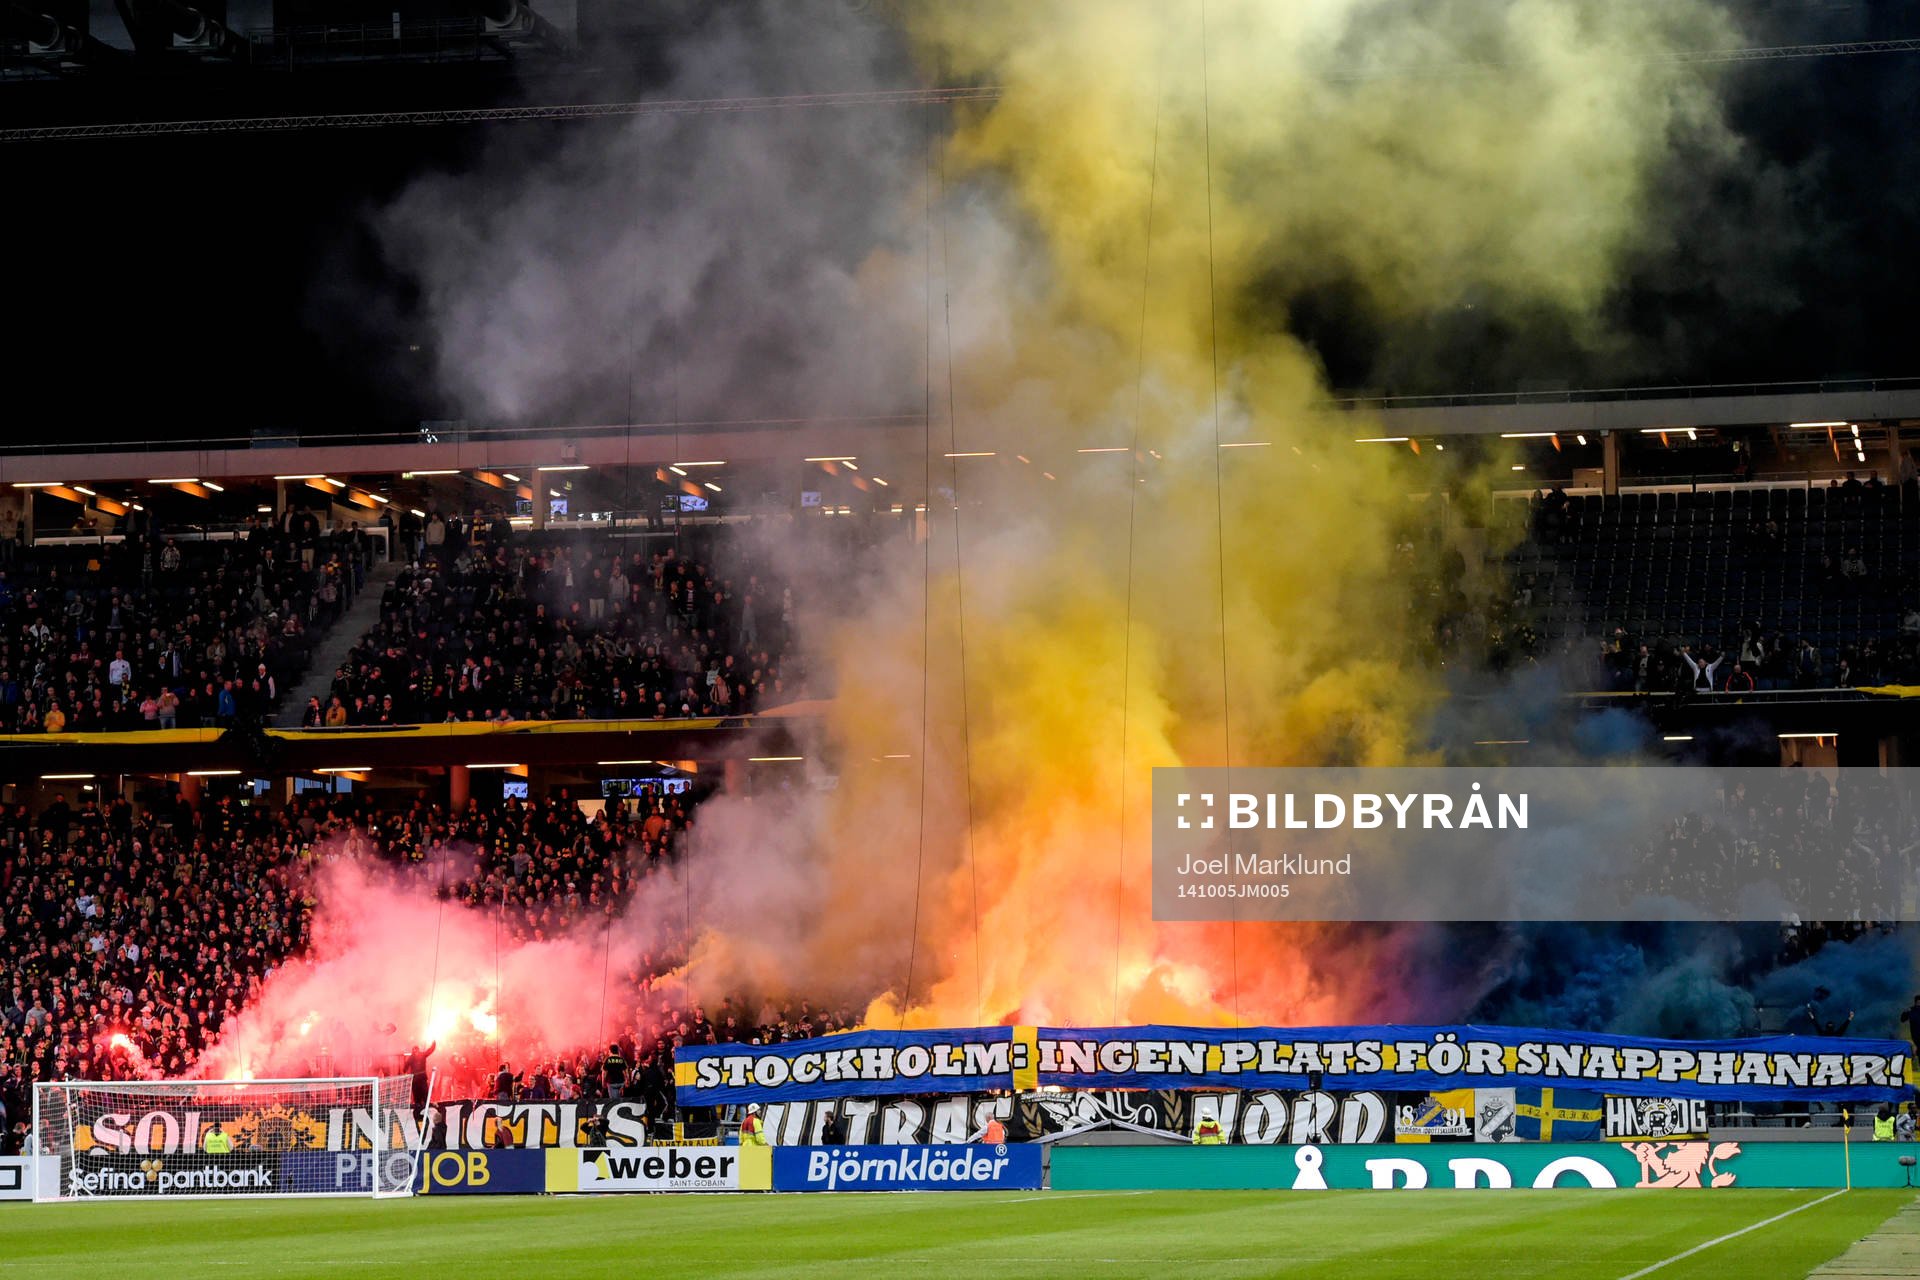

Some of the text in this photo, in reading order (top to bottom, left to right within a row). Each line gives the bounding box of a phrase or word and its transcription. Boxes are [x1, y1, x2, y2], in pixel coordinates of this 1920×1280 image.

[696, 1032, 1905, 1088] STOCKHOLM: INGEN PLATS FÖR SNAPPHANAR!
[69, 1165, 272, 1193] Sefina pantbank
[608, 1149, 735, 1179] weber
